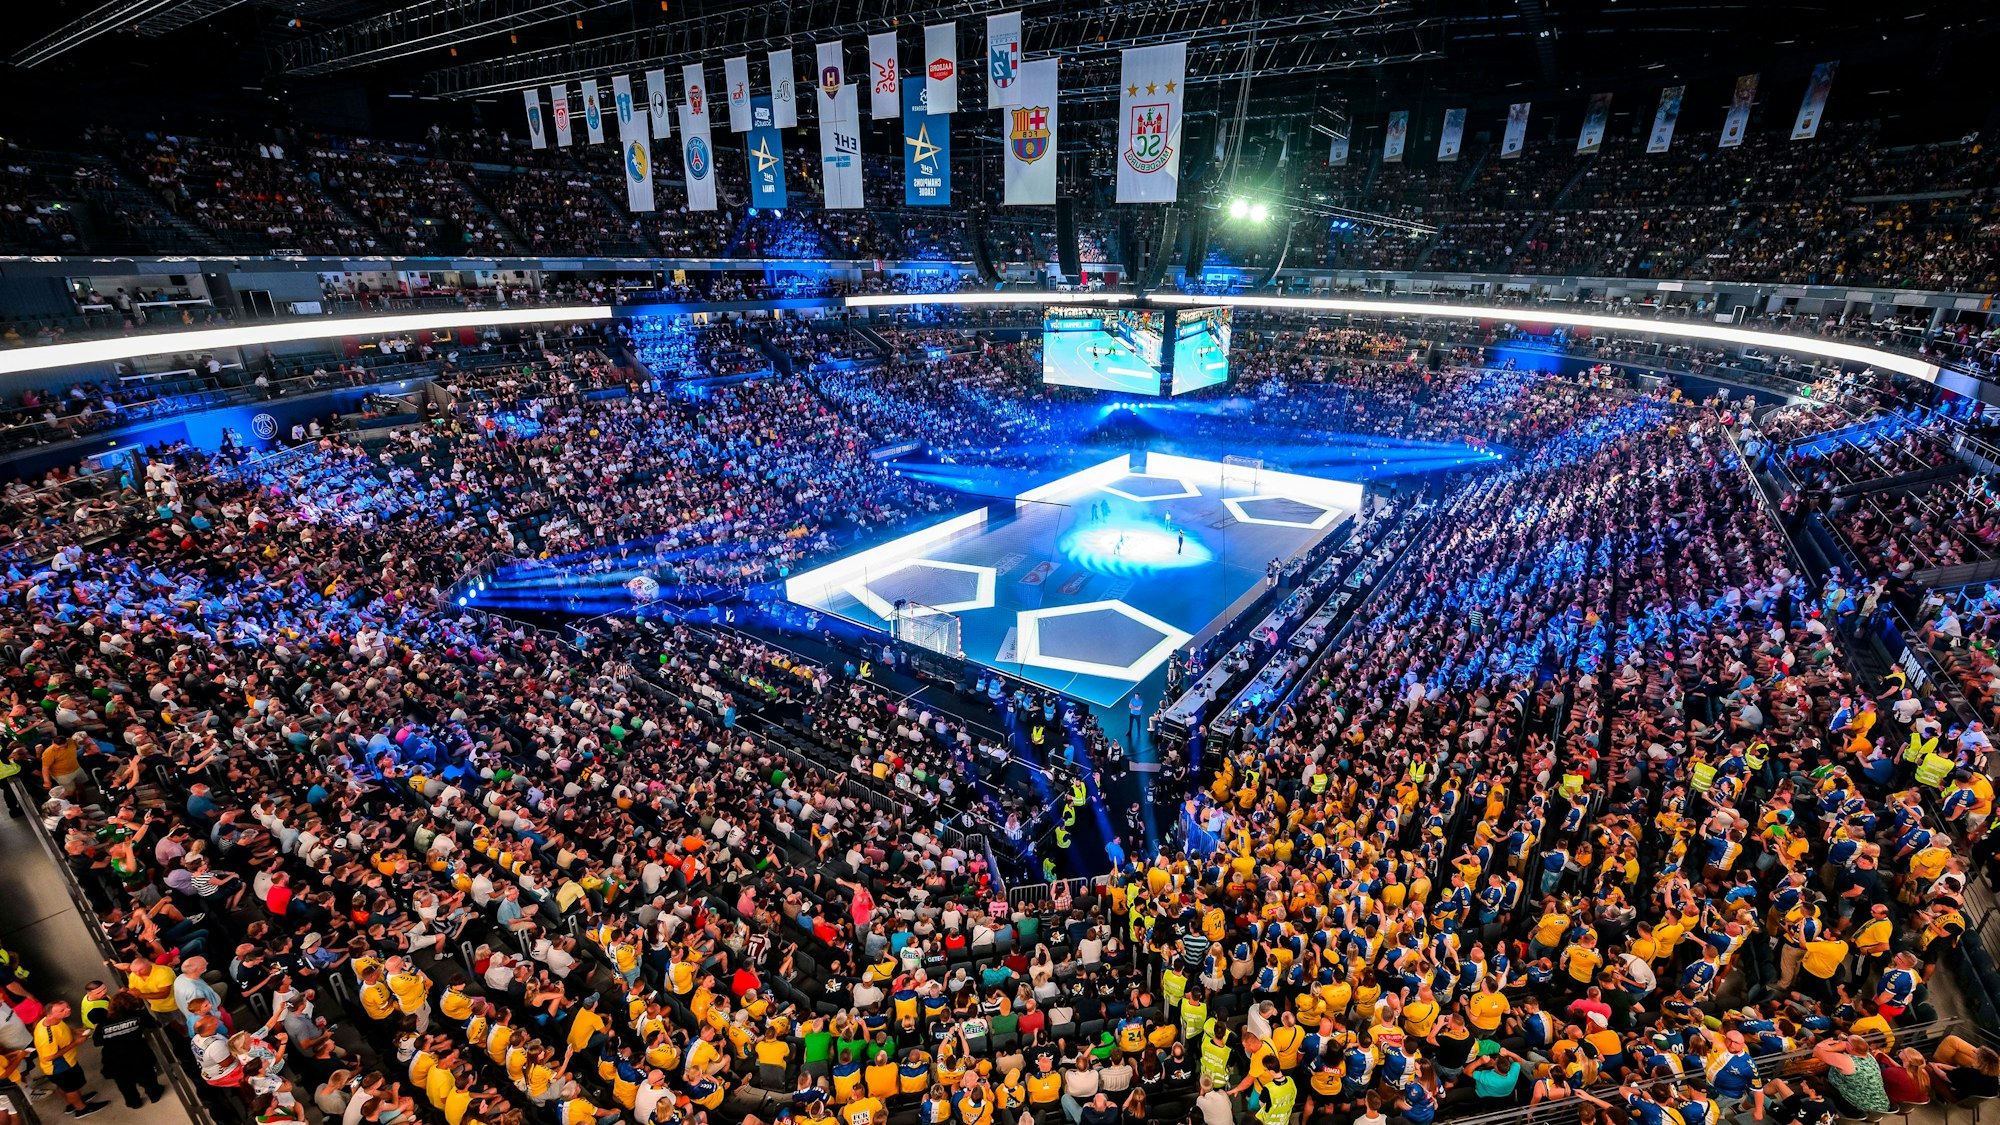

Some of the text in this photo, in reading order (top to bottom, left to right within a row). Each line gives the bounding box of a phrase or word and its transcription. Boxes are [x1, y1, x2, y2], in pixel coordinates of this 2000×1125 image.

[747, 942, 758, 957] 11
[104, 1020, 137, 1034] SECURITY
[1128, 1031, 1142, 1041] 24
[1672, 1043, 1684, 1055] 99
[1326, 1076, 1334, 1085] 2
